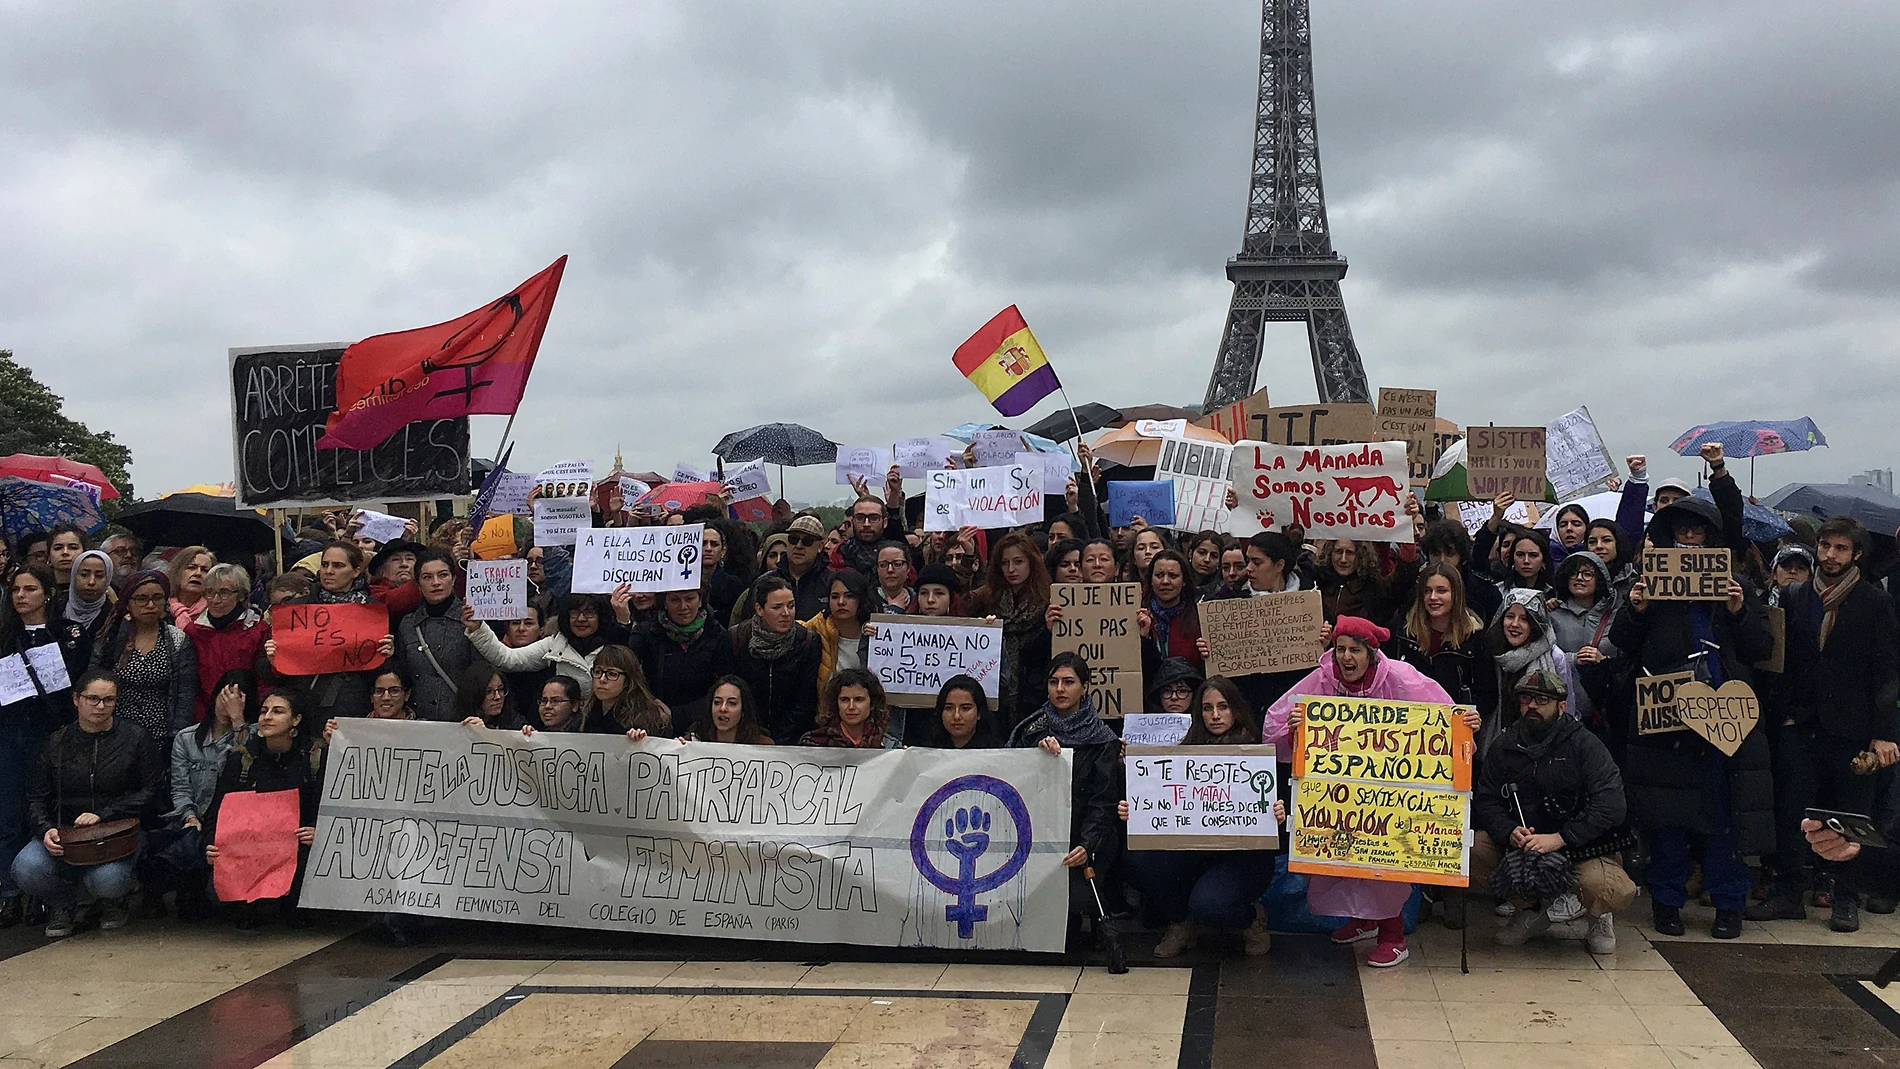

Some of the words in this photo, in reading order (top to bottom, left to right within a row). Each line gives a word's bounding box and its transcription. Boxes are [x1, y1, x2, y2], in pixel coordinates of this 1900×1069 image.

[244, 359, 340, 421] ARRÊTE
[1398, 391, 1423, 403] N'EST
[1382, 420, 1406, 431] C'EST
[1412, 422, 1426, 432] UN
[1477, 430, 1541, 449] SISTER
[1471, 457, 1495, 468] HERE
[1513, 459, 1541, 469] YOUR
[739, 482, 758, 493] CREO
[933, 472, 956, 489] Sin
[971, 478, 986, 489] un
[1010, 467, 1034, 490] Sí
[1252, 474, 1326, 500] Somos
[936, 503, 950, 515] es
[969, 488, 1040, 512] VIOLACIÓN
[1290, 496, 1396, 529] Nosotras
[604, 535, 631, 547] ELLA
[642, 533, 656, 545] LA
[665, 532, 700, 546] CULPAN
[618, 550, 645, 562] ELLOS
[650, 549, 672, 563] LOS
[1645, 553, 1669, 572] JE
[1680, 553, 1728, 572] SUIS
[485, 566, 521, 578] FRANCE
[471, 584, 492, 598] pays
[497, 580, 510, 592] des
[1645, 573, 1729, 597] VIOLÉE
[473, 593, 497, 606] droits
[503, 592, 513, 605] du
[1059, 587, 1075, 607] SI
[1082, 586, 1101, 606] JE
[1110, 586, 1136, 606] NE
[1207, 600, 1252, 614] COMBIEN
[291, 606, 330, 632] NO
[1056, 619, 1084, 637] DIS
[1100, 618, 1128, 637] PAS
[1222, 612, 1238, 622] VIE
[1240, 611, 1255, 620] DE
[1223, 620, 1260, 631] FEMMES
[1262, 613, 1313, 627] INNOCENTES
[314, 629, 346, 646] ES
[874, 626, 893, 642] LA
[902, 630, 959, 651] MANADA
[965, 632, 990, 650] NO
[343, 632, 377, 667] NO
[874, 646, 894, 656] SON
[925, 653, 940, 666] ES
[949, 652, 966, 669] EL
[1218, 658, 1266, 672] BORDEL
[1282, 650, 1319, 665] MERDE!
[880, 666, 942, 688] SISTEMA
[1091, 688, 1122, 715] ON
[1677, 697, 1758, 720] RESPECTE
[1138, 717, 1183, 726] JUSTICIA
[1306, 701, 1410, 725] COBARDE
[1423, 708, 1450, 728] LA
[1641, 705, 1683, 730] AUSS
[1705, 721, 1744, 742] MOI
[1135, 760, 1149, 776] SI
[1154, 759, 1173, 781] TE
[1186, 759, 1252, 784] RESISTES
[1310, 753, 1454, 781] ESPAÑOLA
[330, 746, 442, 803] ANTE
[442, 755, 471, 800] LA
[469, 743, 608, 814] JUSTICIA
[627, 751, 863, 825] PATRIARCAL
[1162, 784, 1188, 806] TE
[1192, 785, 1231, 802] MATAN
[1131, 796, 1140, 811] Y
[1157, 799, 1172, 811] NO
[1182, 800, 1195, 811] LO
[1202, 800, 1236, 814] HACES,
[1301, 780, 1321, 798] que
[1318, 782, 1349, 804] NO
[1354, 787, 1435, 814] SENTENCIA
[1442, 805, 1461, 818] LA
[1151, 815, 1168, 831] QUE
[1176, 815, 1191, 828] FUE
[1201, 815, 1258, 828] CONSENTIDO
[1298, 803, 1394, 837] VIOLACIÓN
[1394, 817, 1404, 830] de
[1408, 818, 1422, 834] La
[1423, 821, 1462, 836] Manada
[314, 816, 573, 896] AUTODEFENSA
[621, 835, 878, 913] FEMINISTA
[364, 888, 441, 909] ASAMBLEA
[456, 897, 521, 916] FEMINISTA
[539, 902, 566, 919] DEL
[589, 905, 657, 926] COLEGIO
[670, 909, 687, 926] DE
[705, 911, 753, 929] ESPAÑA
